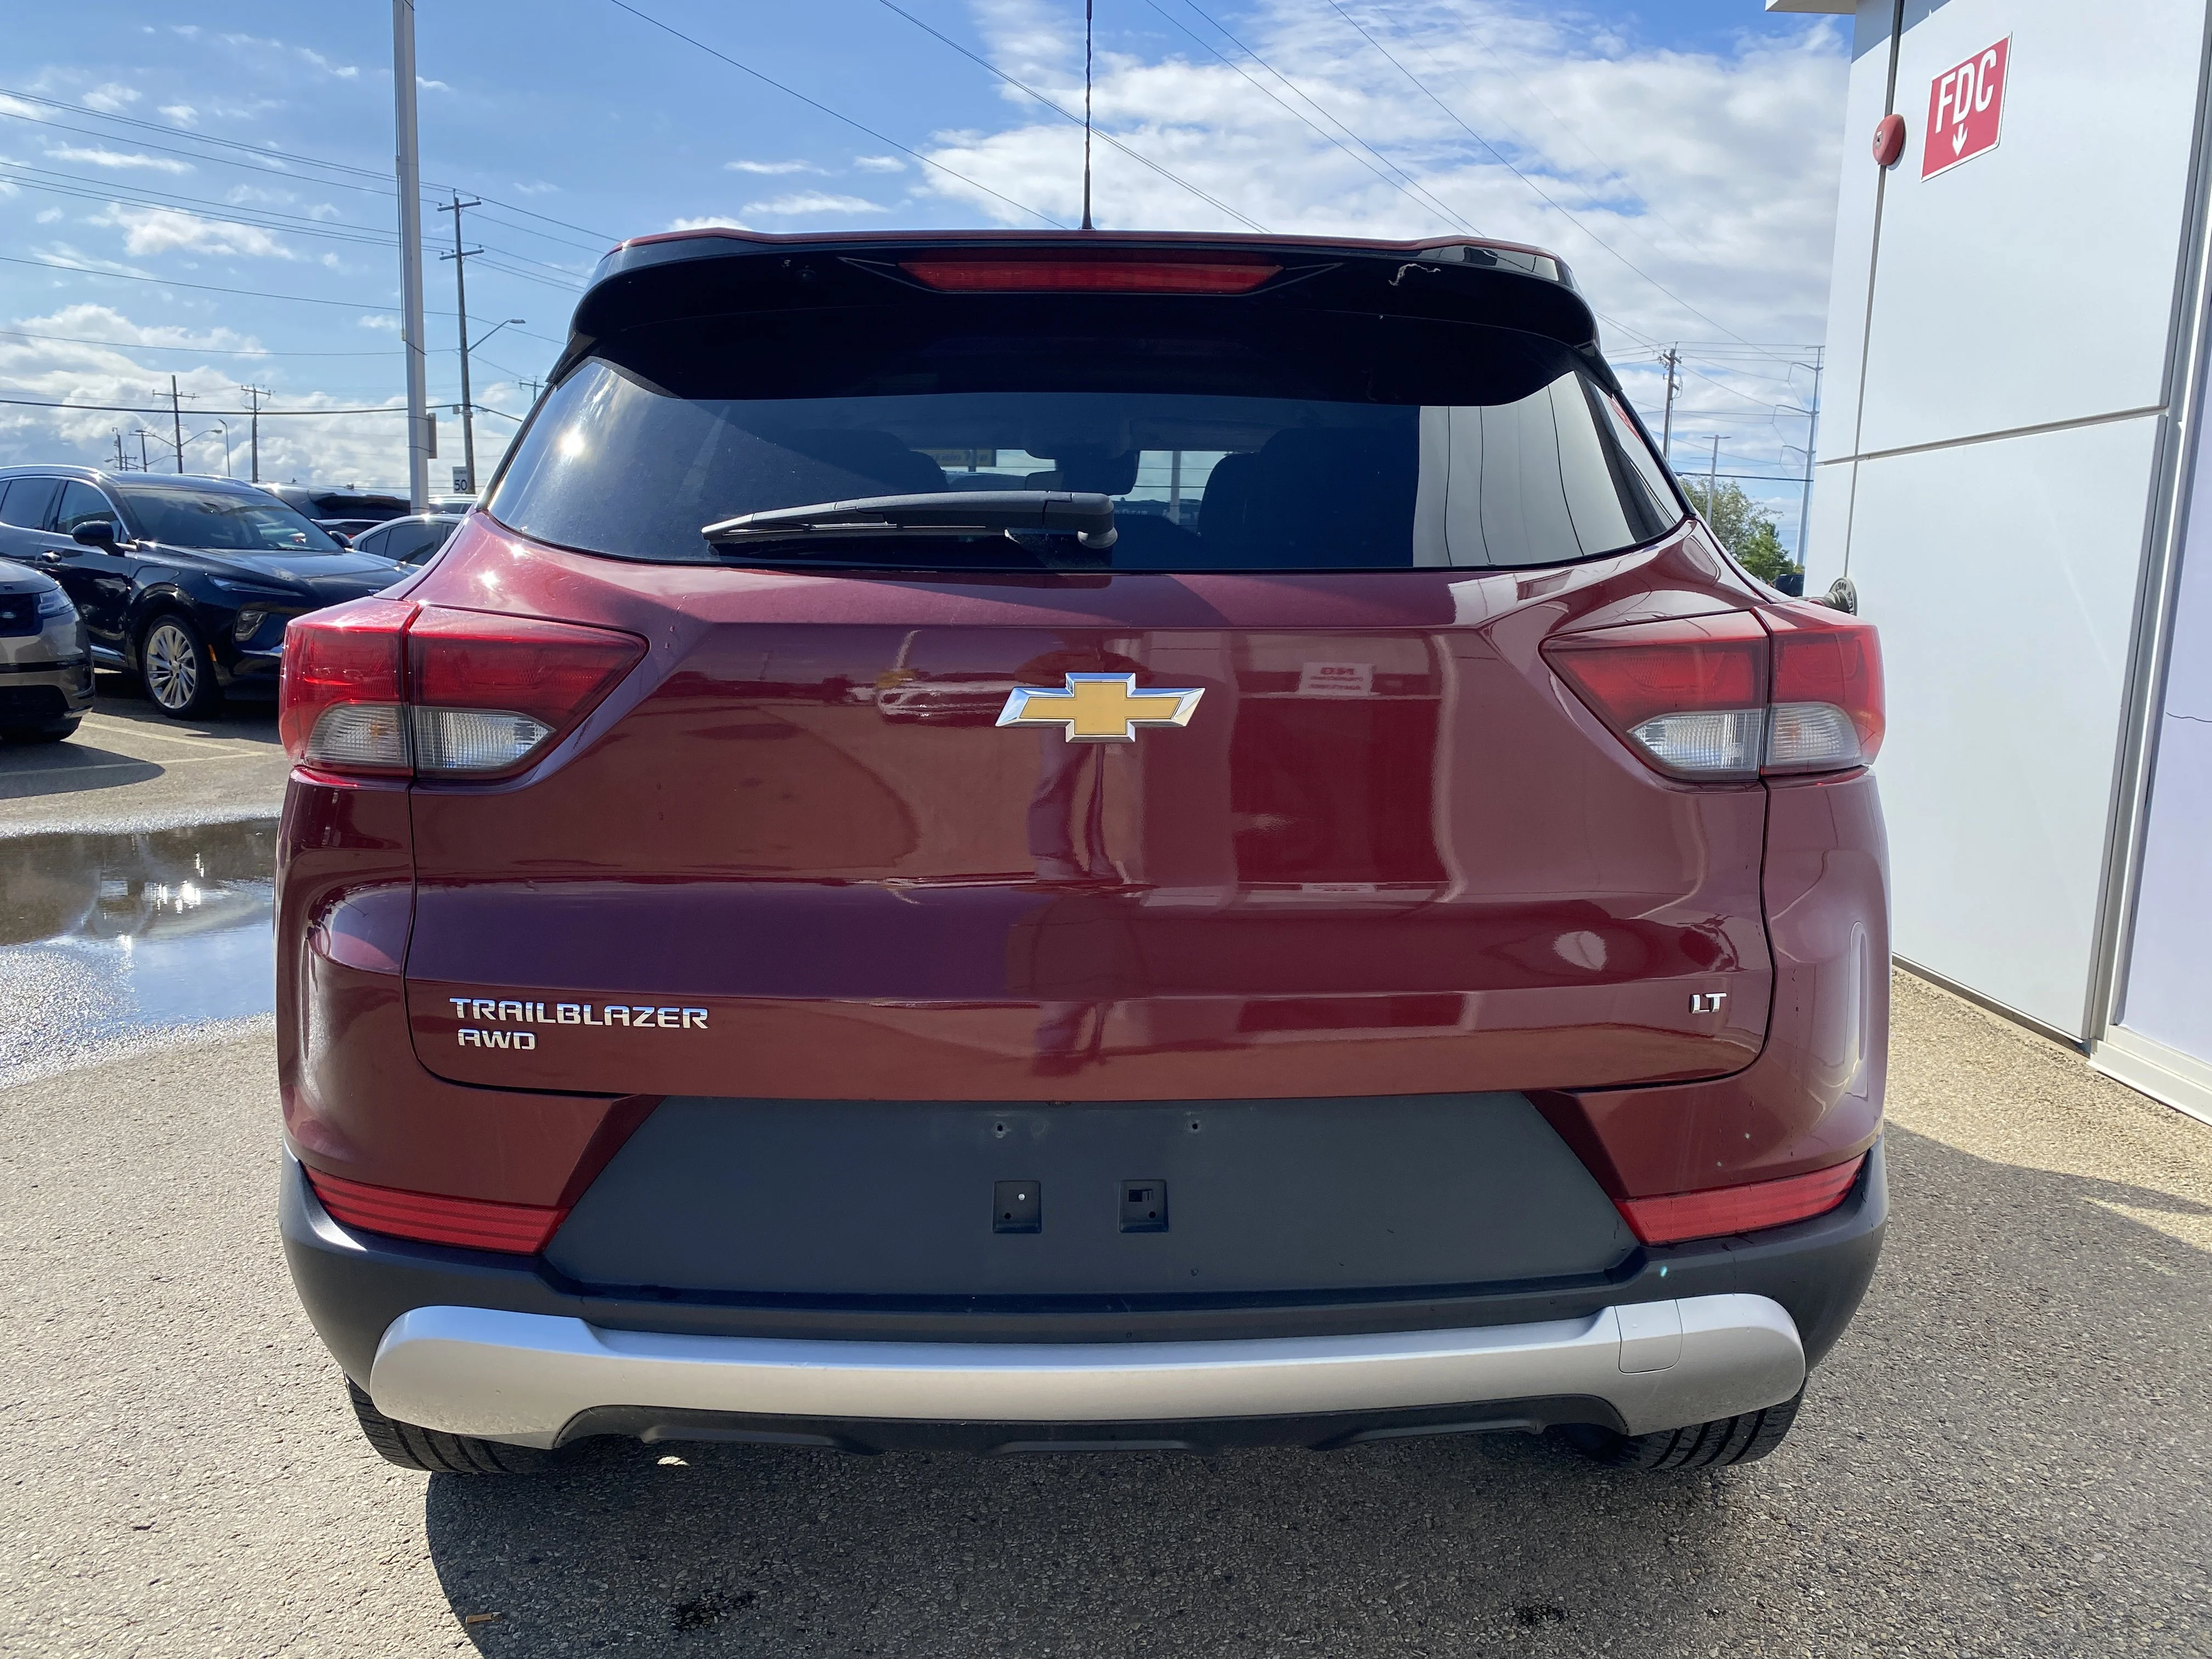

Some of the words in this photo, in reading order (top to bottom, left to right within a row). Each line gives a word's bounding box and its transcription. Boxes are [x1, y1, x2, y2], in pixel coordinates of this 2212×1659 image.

[1936, 49, 1997, 134] FDC
[454, 479, 467, 491] 50
[449, 997, 709, 1029] TRAILBLAZER
[1690, 992, 1727, 1014] LT
[457, 1028, 537, 1050] AWD
